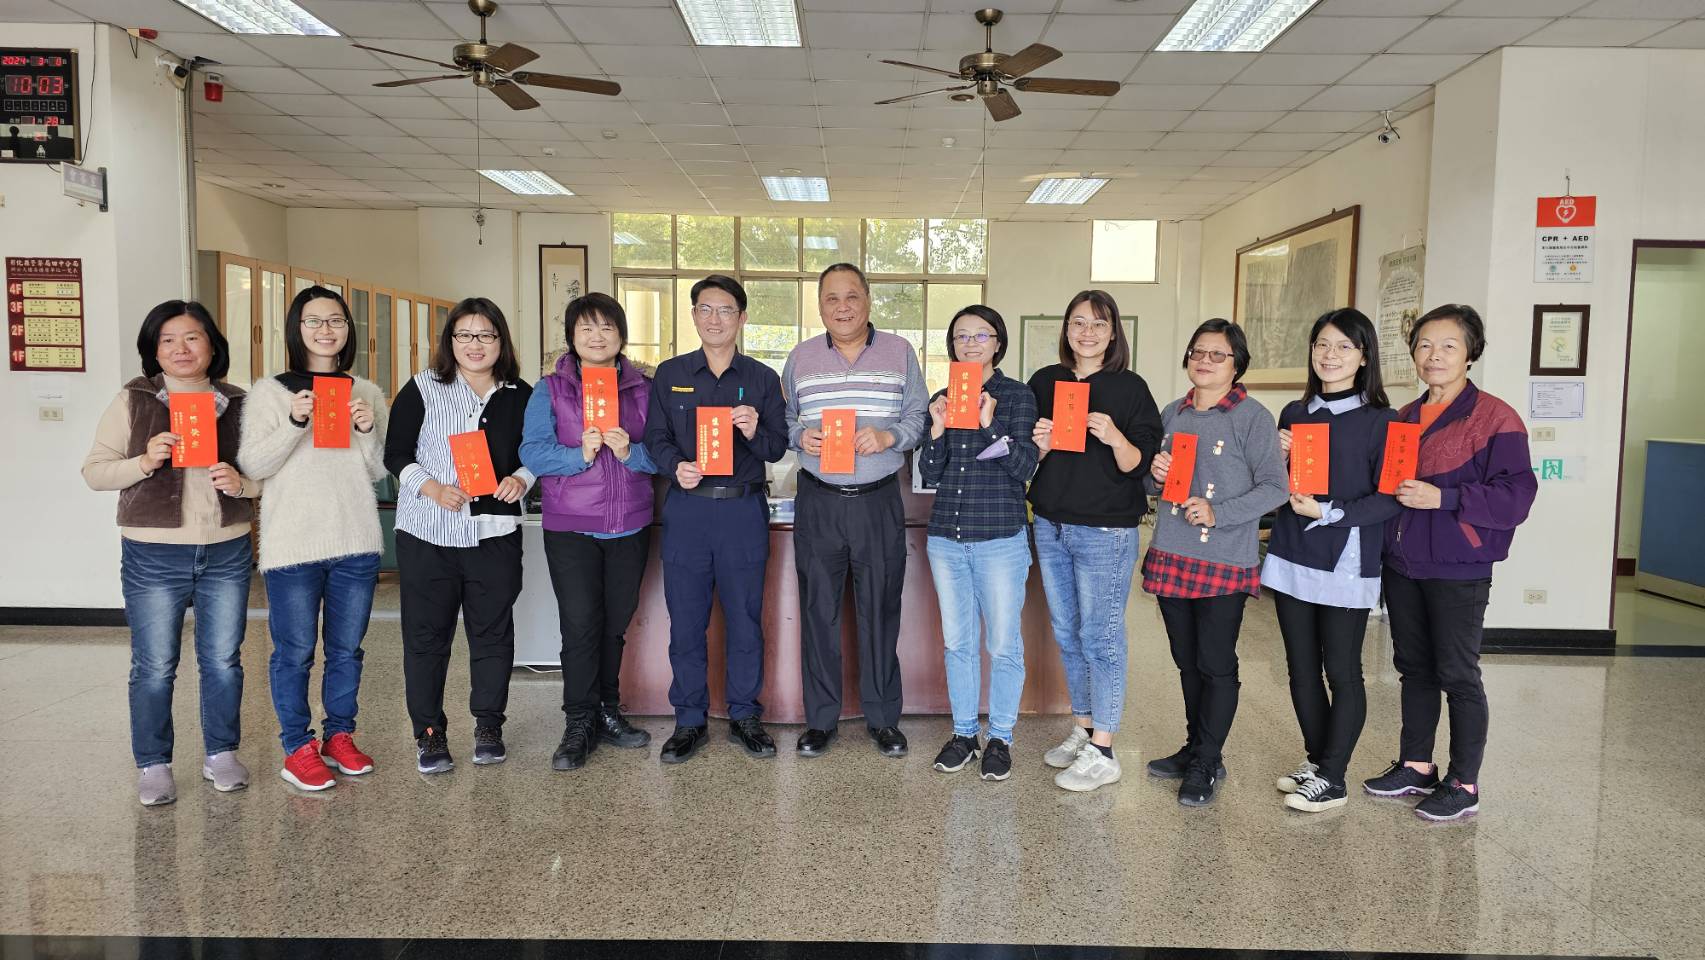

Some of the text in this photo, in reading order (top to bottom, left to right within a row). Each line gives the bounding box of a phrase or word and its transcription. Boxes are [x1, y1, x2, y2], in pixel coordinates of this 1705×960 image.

[2, 56, 26, 65] 2024
[39, 77, 62, 94] 03
[10, 283, 22, 294] 4F
[10, 301, 23, 313] 3F
[11, 324, 24, 336] 2F
[12, 350, 25, 362] 1F
